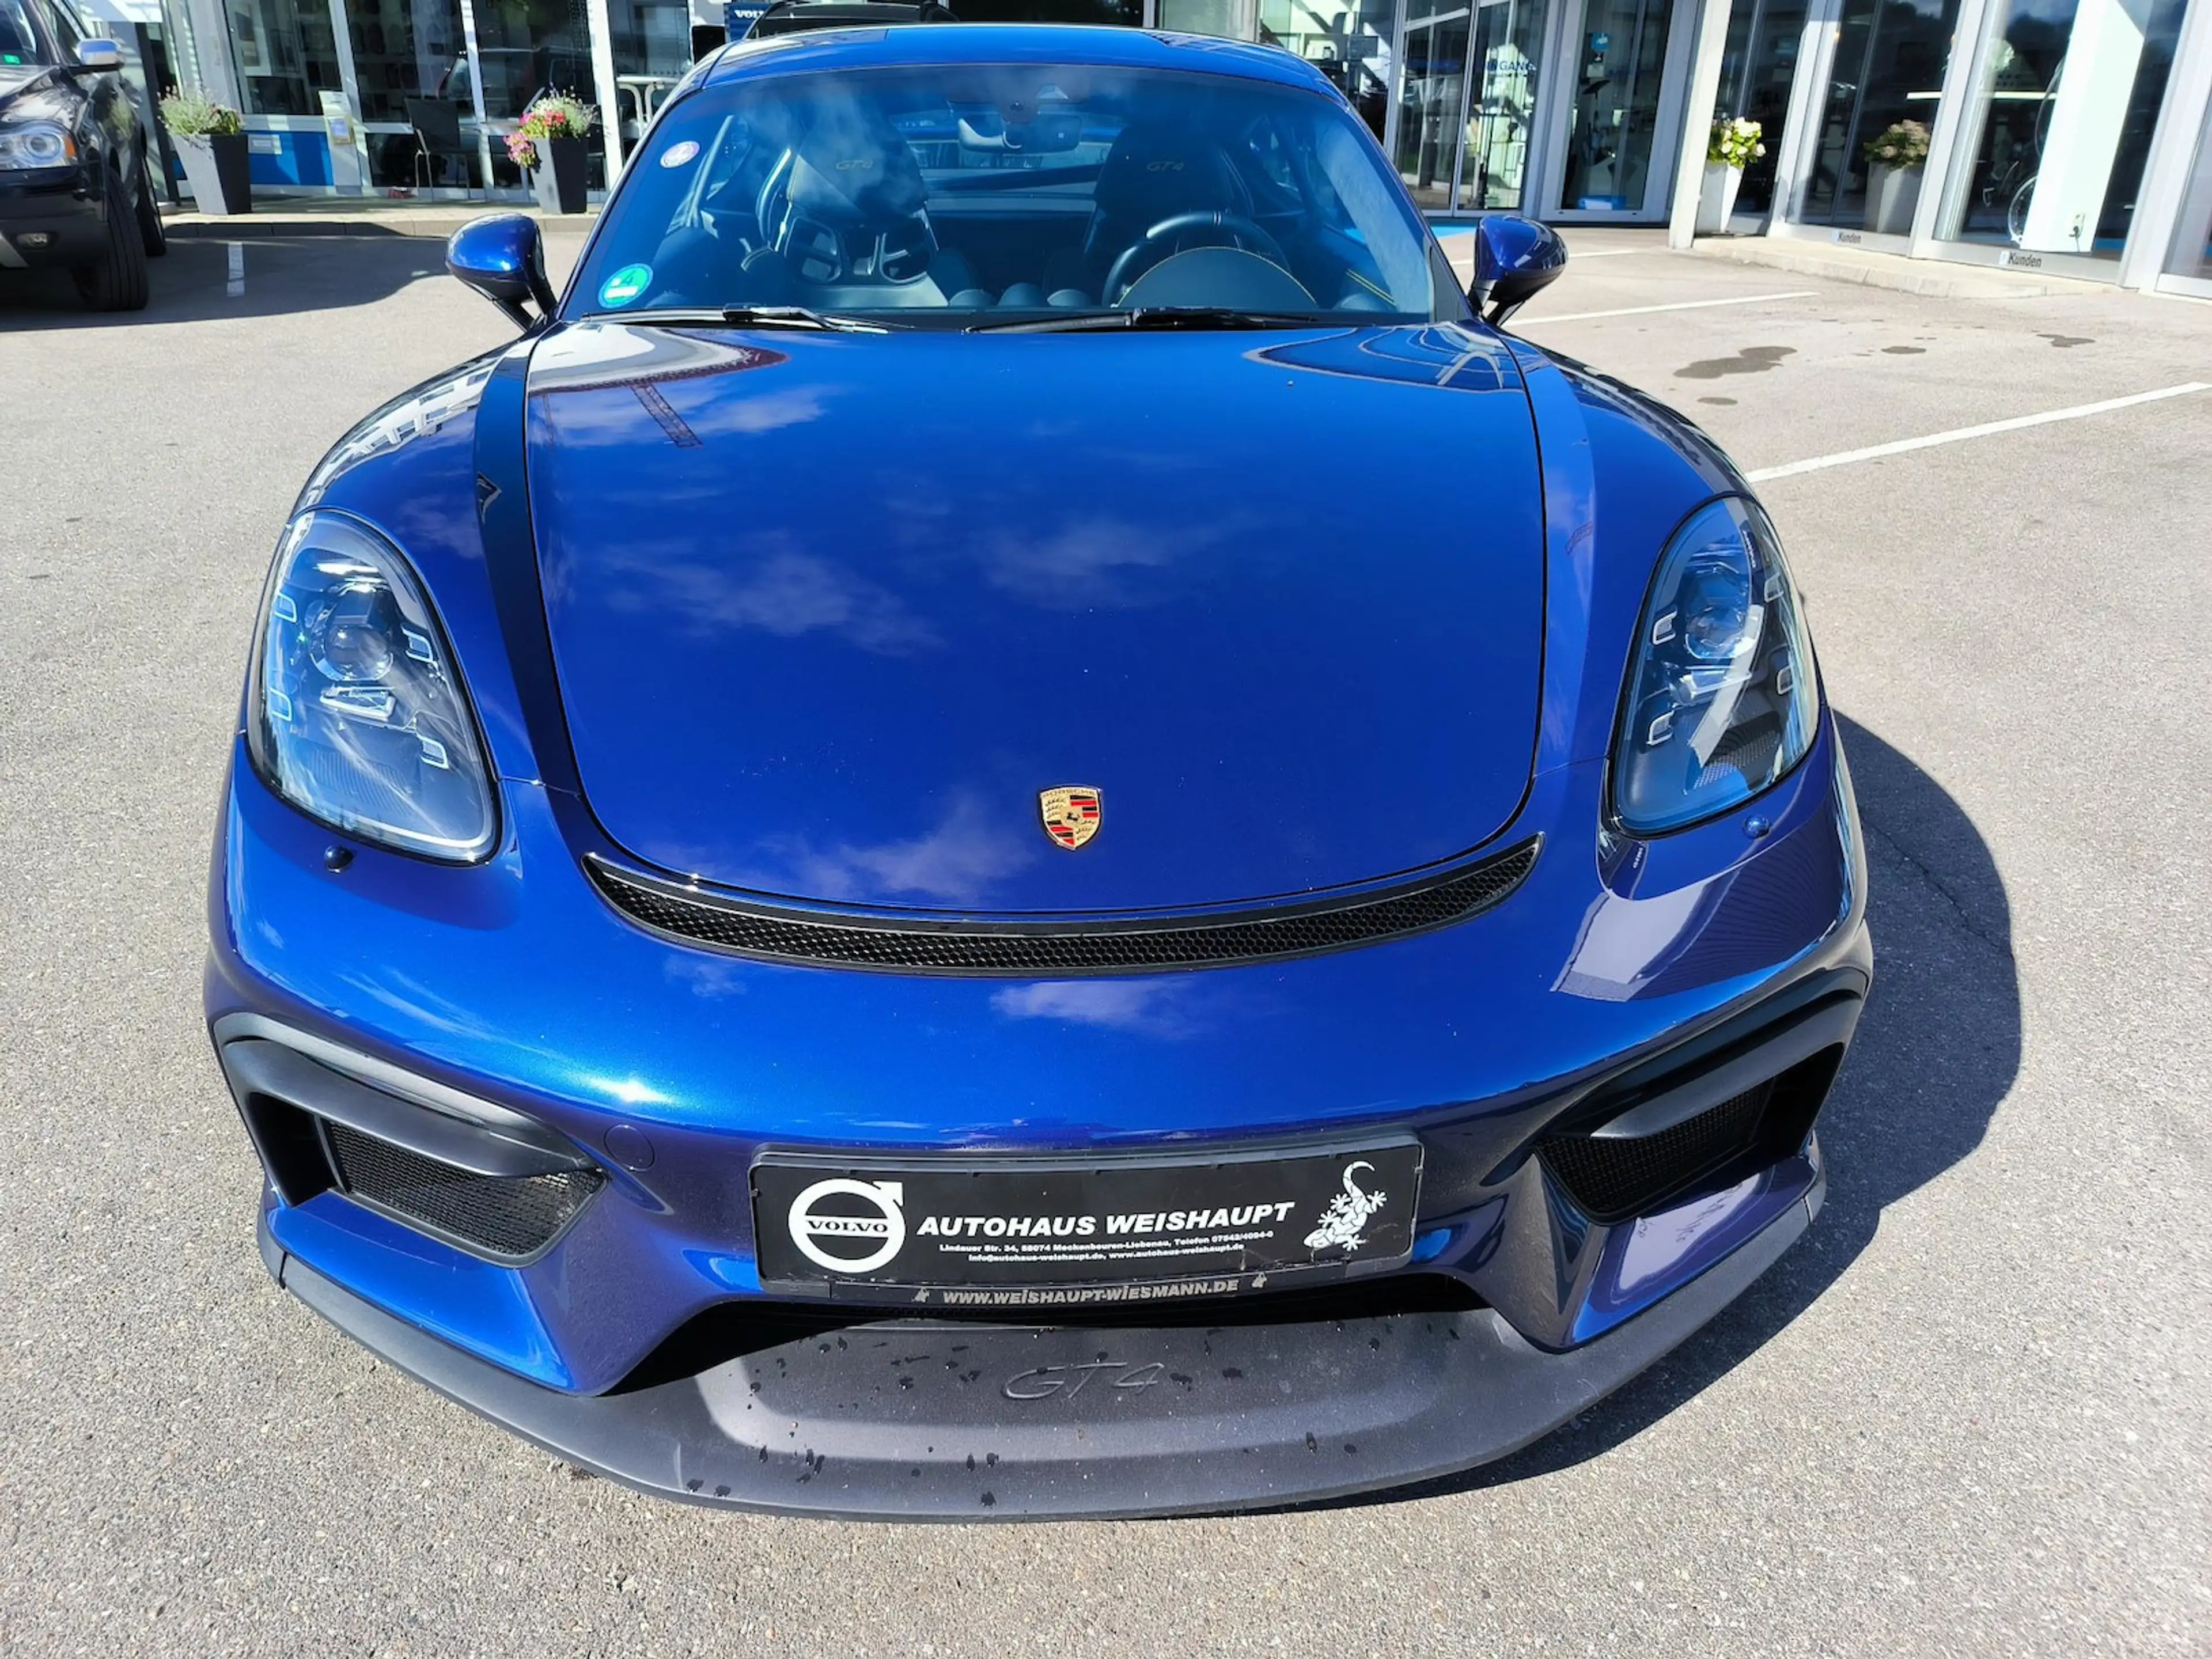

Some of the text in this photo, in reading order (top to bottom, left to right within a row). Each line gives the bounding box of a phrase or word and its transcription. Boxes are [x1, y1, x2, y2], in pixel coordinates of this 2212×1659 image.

[734, 9, 765, 19] VOLV
[1837, 232, 1861, 244] Kunden
[2009, 251, 2041, 268] Kunden
[807, 1220, 888, 1233] VOLVO
[916, 1202, 1296, 1237] AUTOHAUS WEISHAUPT
[940, 1244, 982, 1252] Lindauer
[984, 1244, 1002, 1252] Str.
[1003, 1244, 1020, 1253] 34,
[1173, 1236, 1210, 1246] Telefon
[1004, 1361, 1165, 1399] GT4
